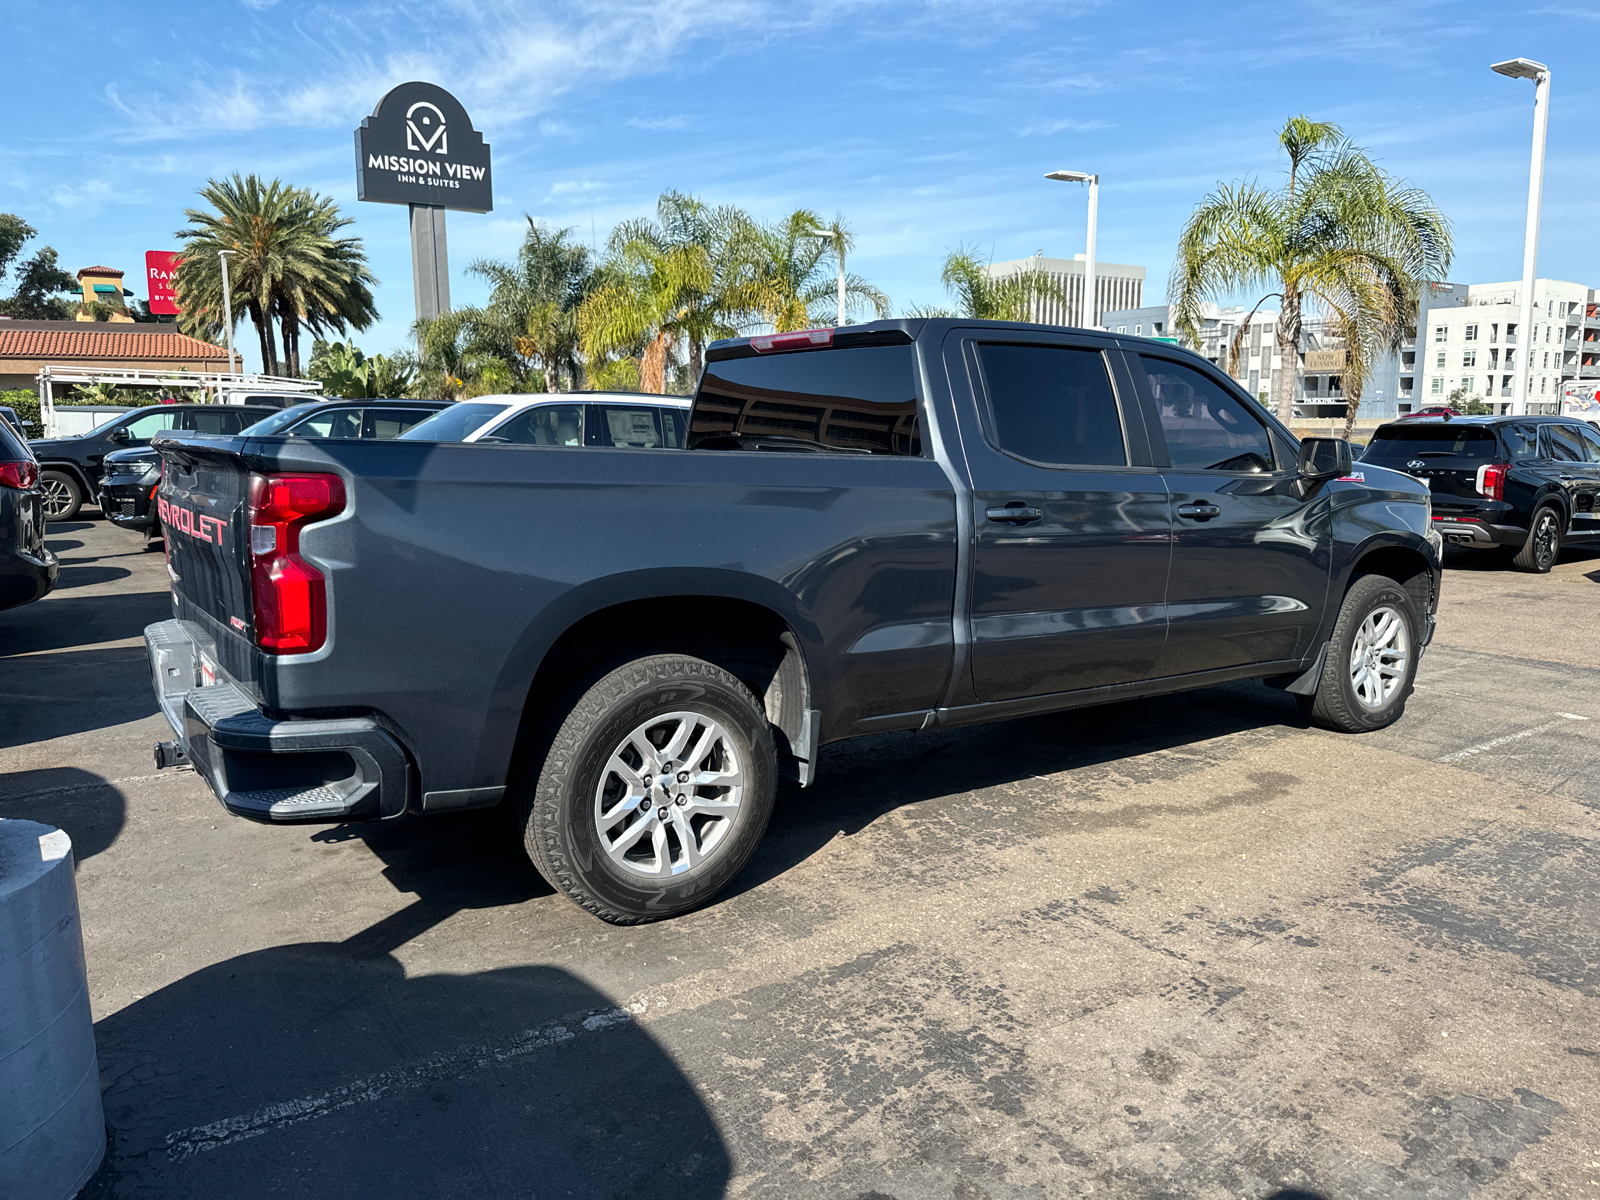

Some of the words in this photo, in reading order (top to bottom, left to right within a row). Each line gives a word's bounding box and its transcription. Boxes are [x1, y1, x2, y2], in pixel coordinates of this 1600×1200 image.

[368, 153, 441, 176] MISSION
[444, 162, 486, 181] VIEW
[397, 174, 416, 184] INN
[418, 176, 425, 185] &
[427, 178, 460, 189] SUITES
[150, 268, 179, 280] RAM
[574, 691, 677, 841] GOODYEAR
[678, 758, 768, 898] WRANGLER
